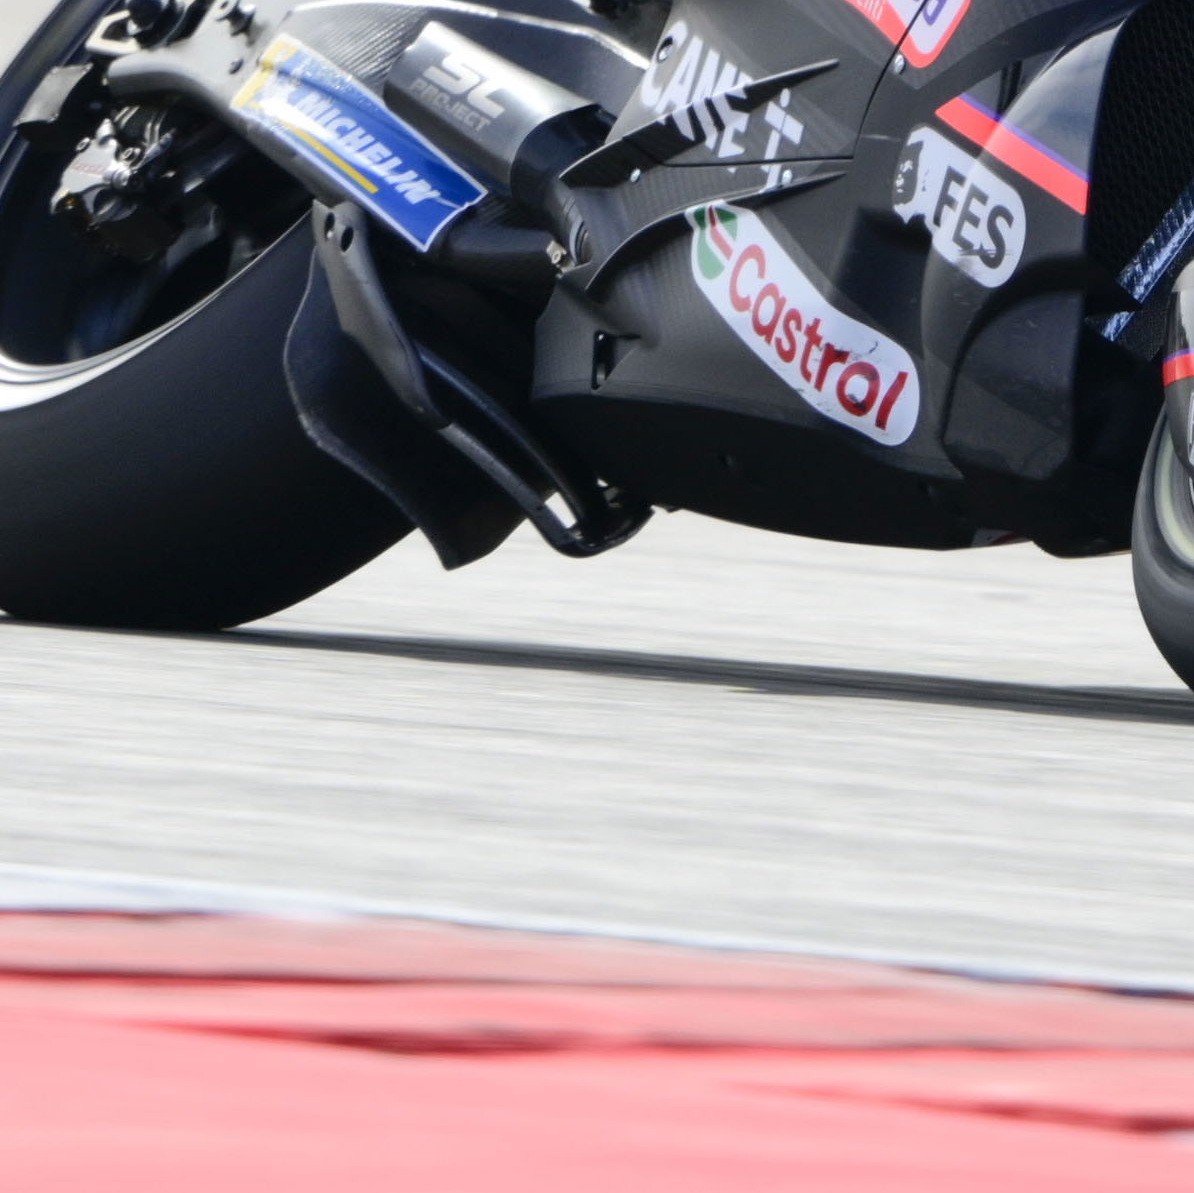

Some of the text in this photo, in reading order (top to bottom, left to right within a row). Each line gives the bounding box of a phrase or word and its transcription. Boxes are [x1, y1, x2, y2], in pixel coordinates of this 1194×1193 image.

[295, 90, 441, 205] MICHELIN
[408, 77, 491, 132] PROJECT
[729, 244, 909, 431] Castrol
